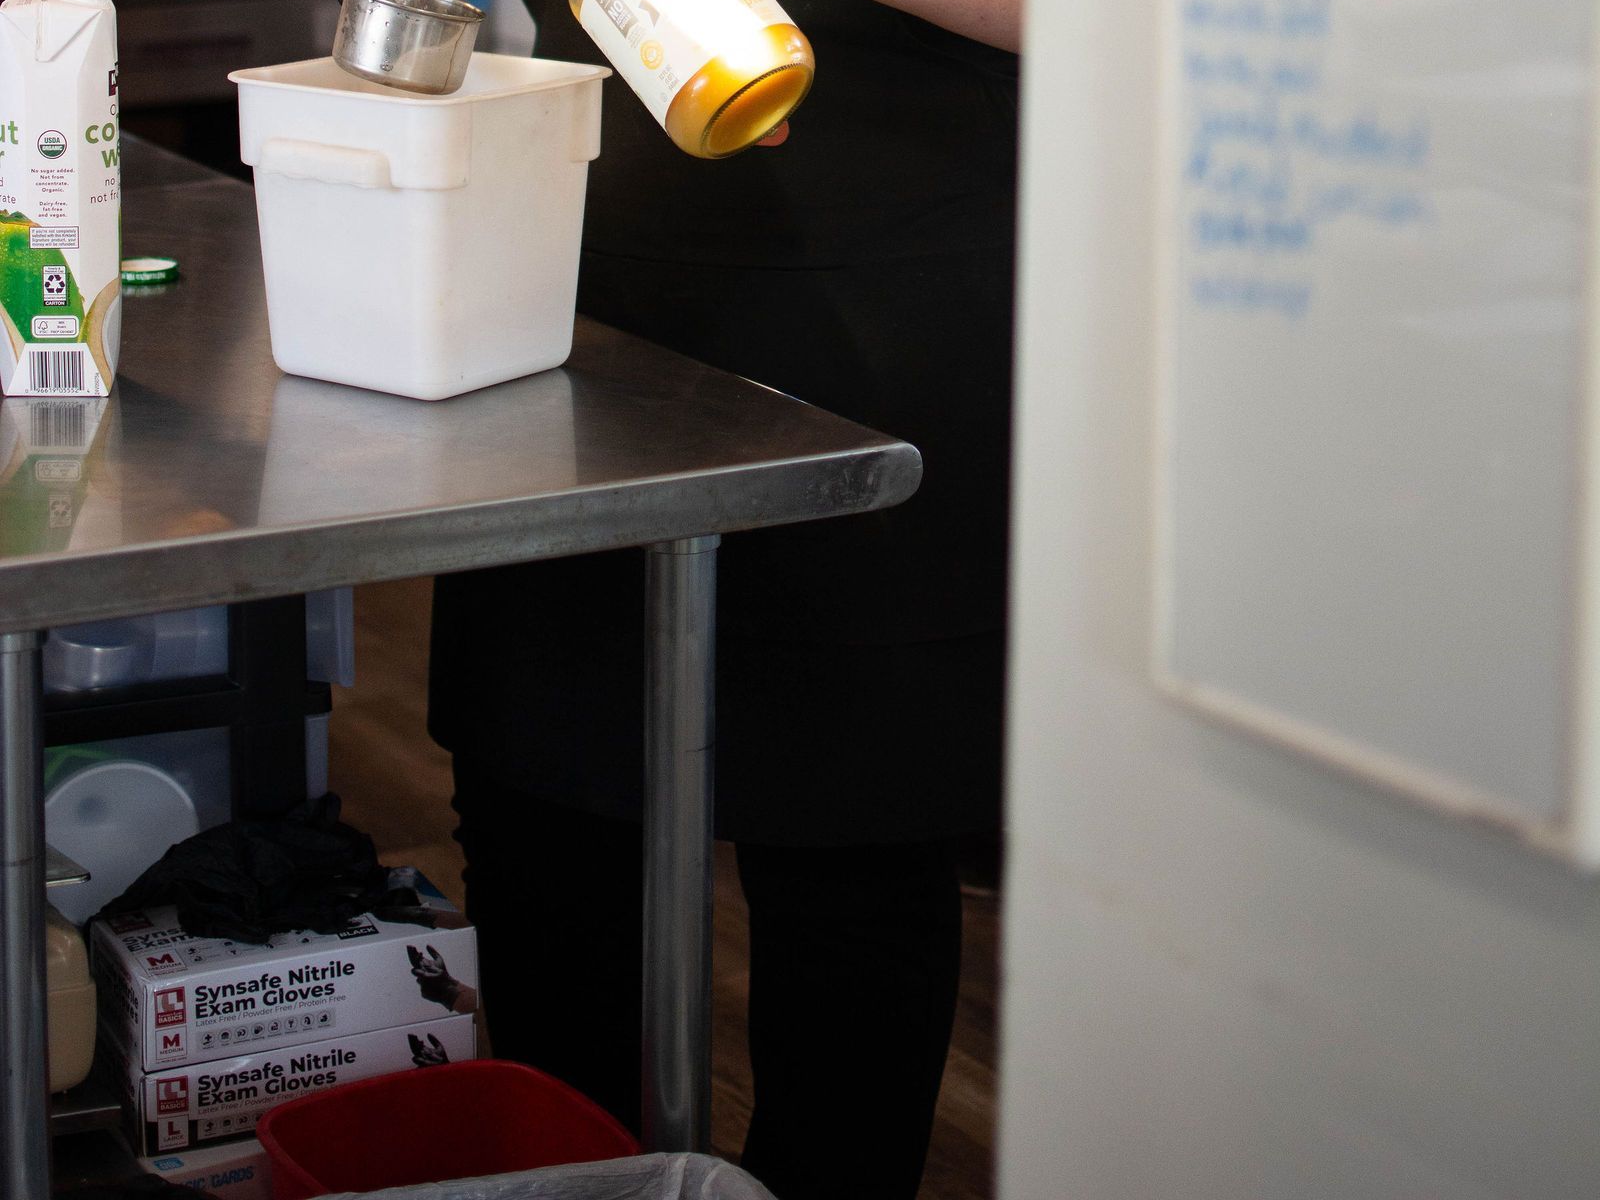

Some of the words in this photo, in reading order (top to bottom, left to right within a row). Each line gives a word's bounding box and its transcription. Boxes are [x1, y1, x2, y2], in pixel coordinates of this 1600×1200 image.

[90, 194, 107, 203] not
[339, 926, 376, 938] BLACK
[147, 953, 174, 967] M
[195, 973, 282, 1004] Synsafe
[289, 960, 355, 986] Nitrile
[195, 996, 256, 1019] Exam
[263, 982, 336, 1006] Gloves
[158, 1013, 183, 1023] BASICS
[196, 1018, 217, 1028] Latex
[219, 1014, 237, 1023] Free
[243, 1008, 273, 1019] Powder
[275, 1003, 293, 1013] Free
[299, 997, 327, 1009] Protein
[329, 994, 346, 1003] Free
[163, 1033, 180, 1049] M
[160, 1047, 184, 1055] MEDIUM
[198, 1062, 283, 1092] Synsafe
[291, 1049, 356, 1074] Nitrile
[198, 1085, 257, 1107] Exam
[265, 1071, 337, 1095] Gloves
[199, 1105, 219, 1115] Latex
[221, 1102, 239, 1112] Free
[244, 1095, 275, 1107] Powder
[168, 1121, 181, 1136] L
